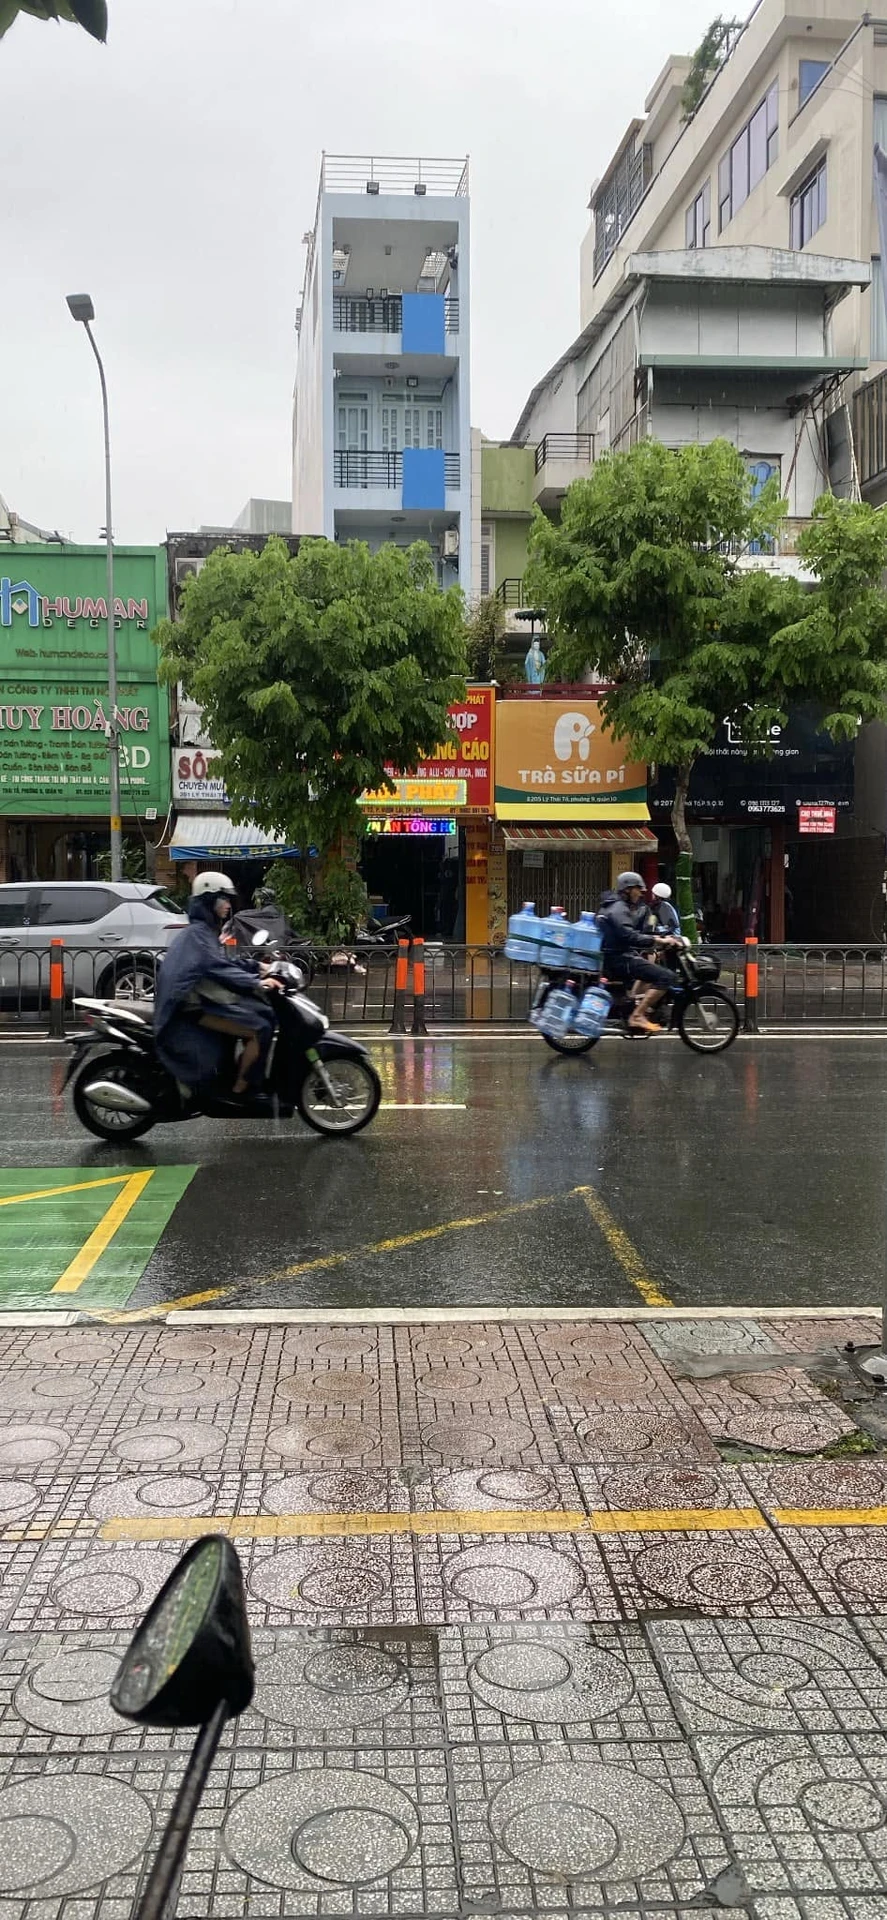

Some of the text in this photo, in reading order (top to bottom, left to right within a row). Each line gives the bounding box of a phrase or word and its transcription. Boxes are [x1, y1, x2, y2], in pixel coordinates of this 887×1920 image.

[42, 597, 148, 619] HUMAN
[42, 619, 146, 629] DECOR
[39, 650, 118, 660] humandeco.co
[7, 685, 38, 695] CÔNG
[41, 686, 51, 695] TY
[55, 687, 79, 696] TNHH
[82, 687, 95, 696] TM
[0, 699, 150, 731] UY HOÀNG
[462, 737, 489, 760] CÁO
[518, 765, 627, 784] TRÀ SỮA PÍ
[406, 780, 458, 800] PHÁT
